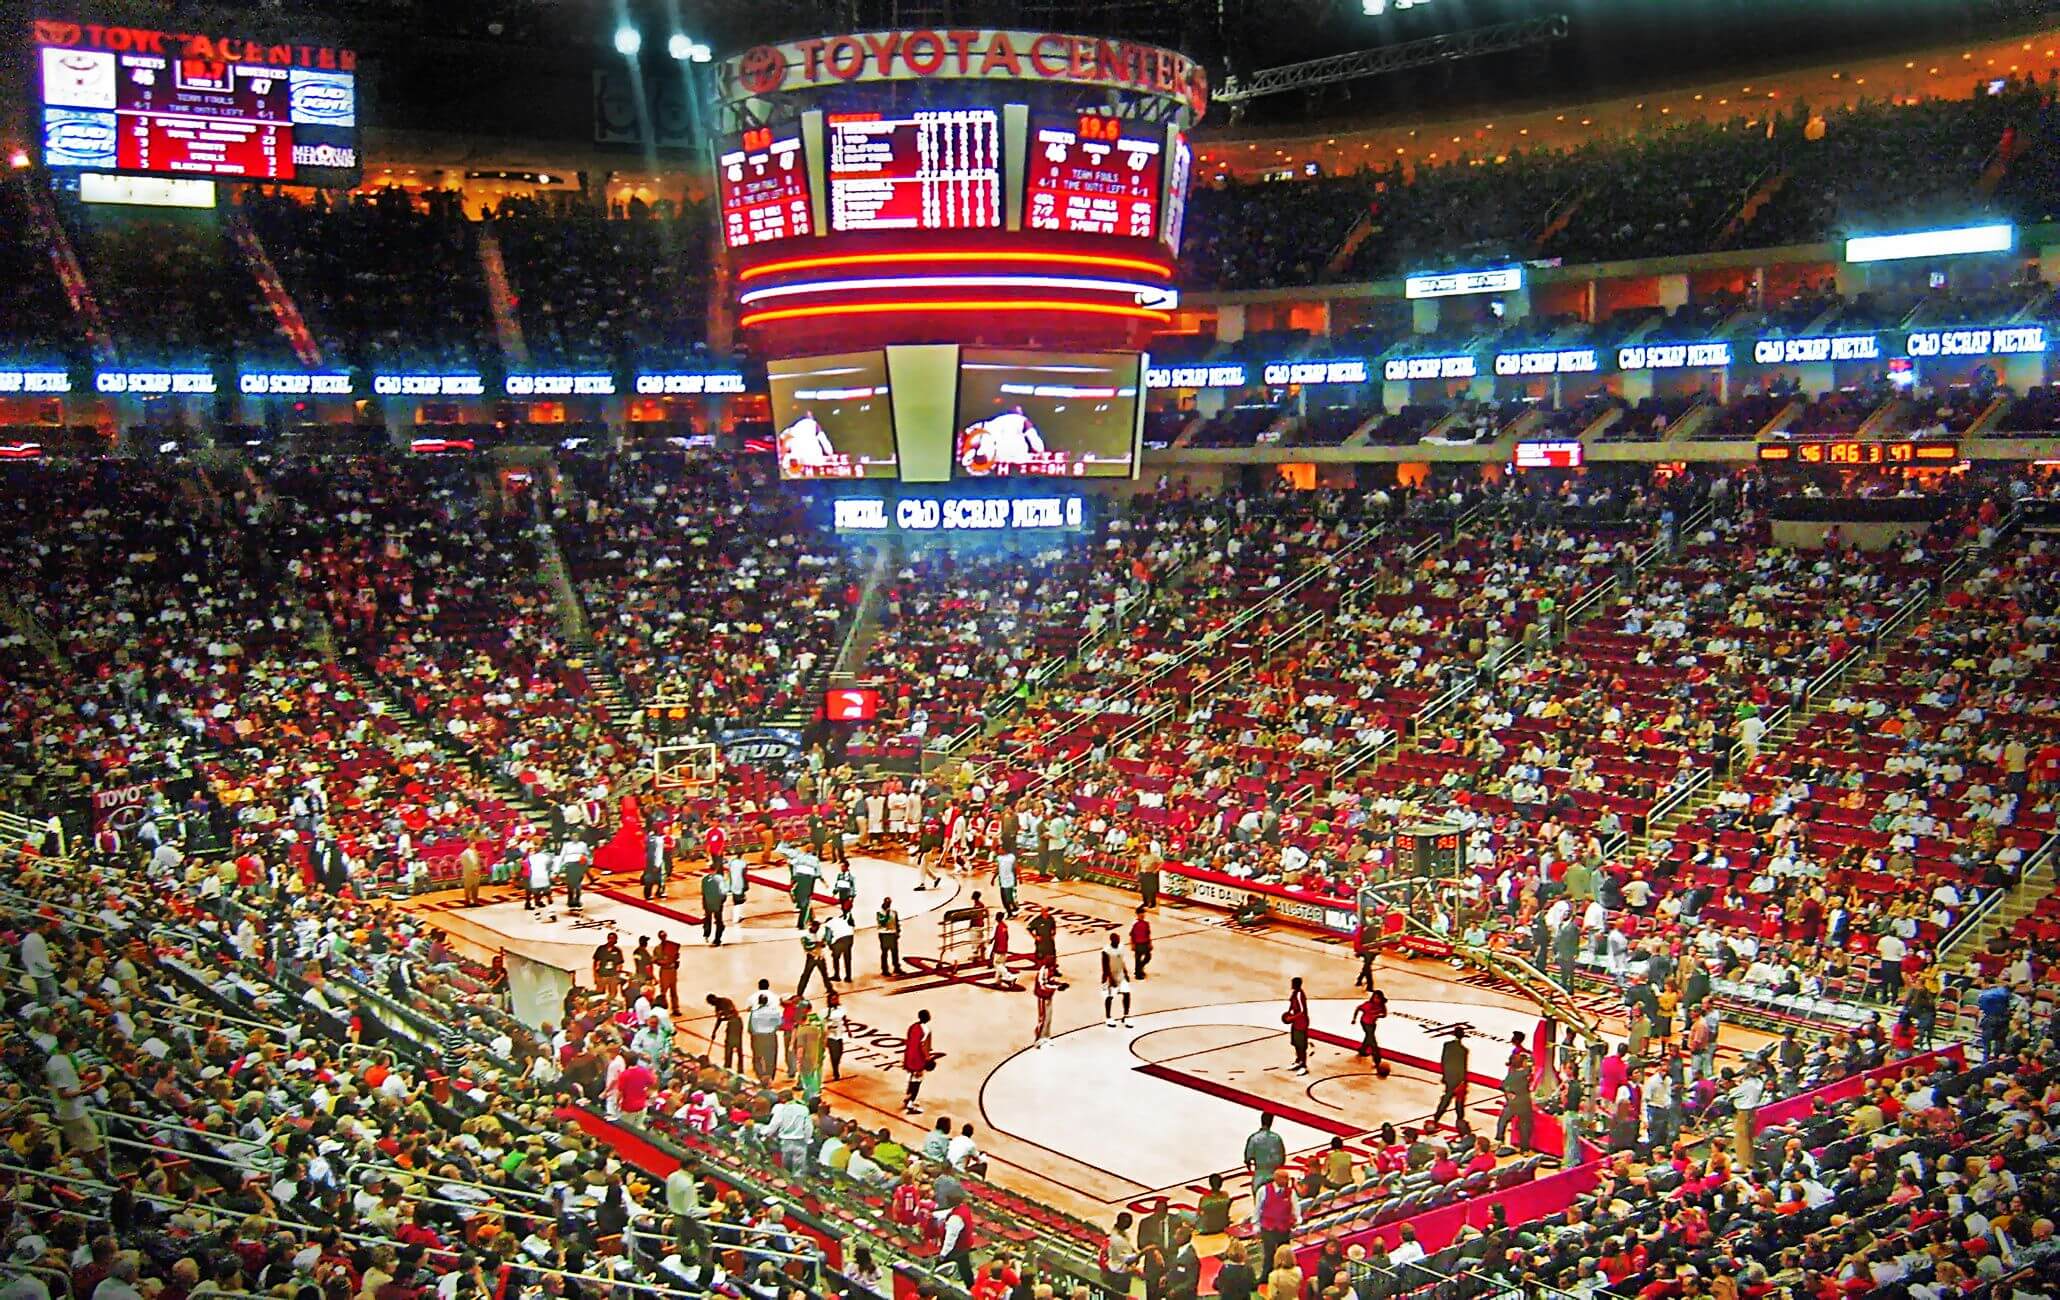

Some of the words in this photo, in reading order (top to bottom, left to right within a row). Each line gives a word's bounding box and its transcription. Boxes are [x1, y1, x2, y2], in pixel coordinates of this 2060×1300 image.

[800, 31, 1021, 81] TOYOTA
[1031, 34, 1192, 94] CENTER
[250, 78, 272, 94] 47
[303, 87, 346, 100] BUD
[297, 97, 353, 112] LIGHT
[61, 126, 107, 140] BUD
[1079, 116, 1119, 140] 19.6
[1106, 183, 1126, 193] LEFT
[1786, 339, 1830, 361] SCRAP
[1831, 337, 1877, 359] METAL
[1942, 331, 1990, 354] SCRAP
[1993, 328, 2045, 352] METAL
[1521, 353, 1557, 373] SCRAP
[1558, 351, 1596, 371] METAL
[1647, 346, 1686, 367] SCRAP
[1687, 344, 1729, 366] METAL
[1290, 364, 1327, 383] SCRAP
[1327, 362, 1366, 383] METAL
[1408, 359, 1440, 378] SCRAP
[1441, 357, 1476, 377] METAL
[24, 373, 71, 391] METAL
[128, 374, 171, 392] SCRAP
[172, 375, 216, 392] METAL
[270, 376, 310, 393] SCRAP
[311, 376, 352, 393] METAL
[534, 377, 573, 393] SCRAP
[574, 377, 615, 393] METAL
[665, 376, 703, 393] SCRAP
[704, 376, 745, 392] METAL
[1172, 369, 1208, 386] SCRAP
[1209, 367, 1244, 386] METAL
[402, 377, 441, 393] SCRAP
[442, 377, 484, 394] METAL
[1802, 445, 1820, 461] 46
[1870, 446, 1879, 461] 3
[1891, 445, 1910, 460] 47
[834, 501, 888, 528] METAL
[943, 500, 1009, 528] SCRAP
[1012, 499, 1063, 527] METAL
[98, 786, 141, 808] TOYO
[1192, 883, 1216, 897] VOTE
